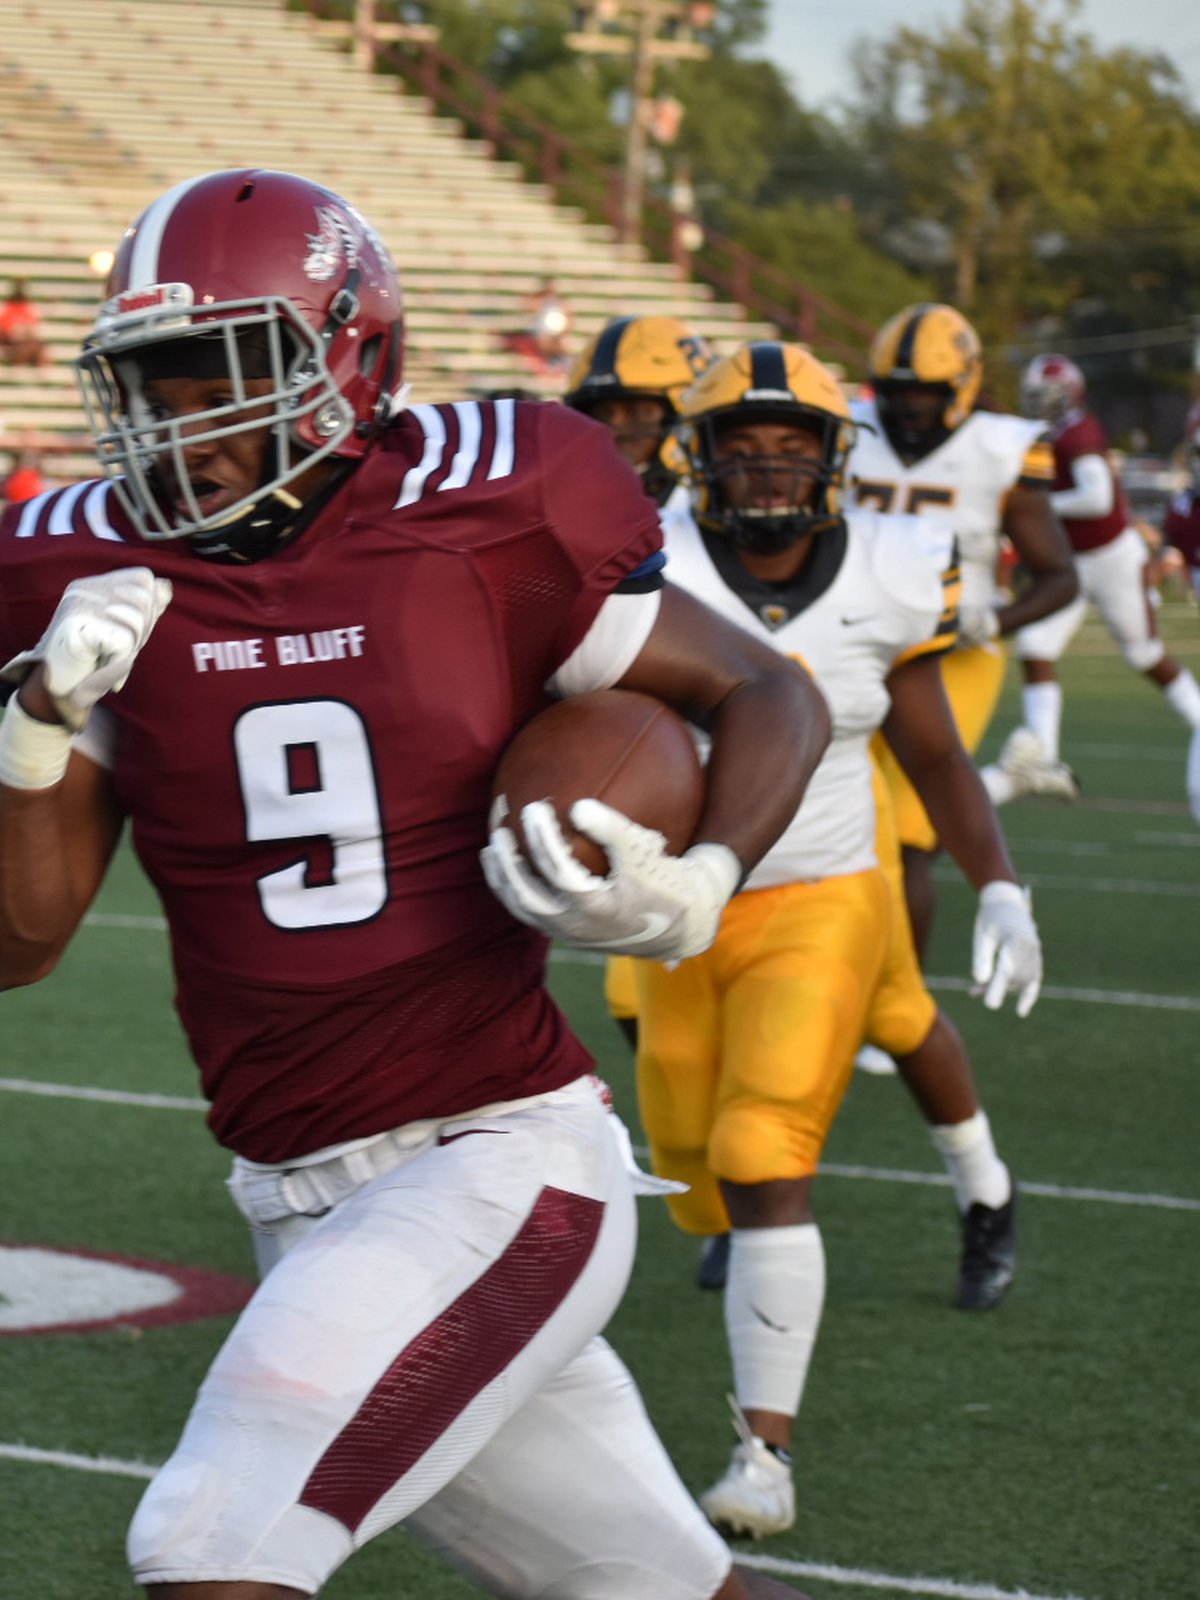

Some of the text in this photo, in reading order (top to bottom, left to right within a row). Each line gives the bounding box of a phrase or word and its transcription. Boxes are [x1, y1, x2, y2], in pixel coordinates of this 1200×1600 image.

[192, 625, 366, 673] PINE BLUFF
[232, 696, 392, 933] 9
